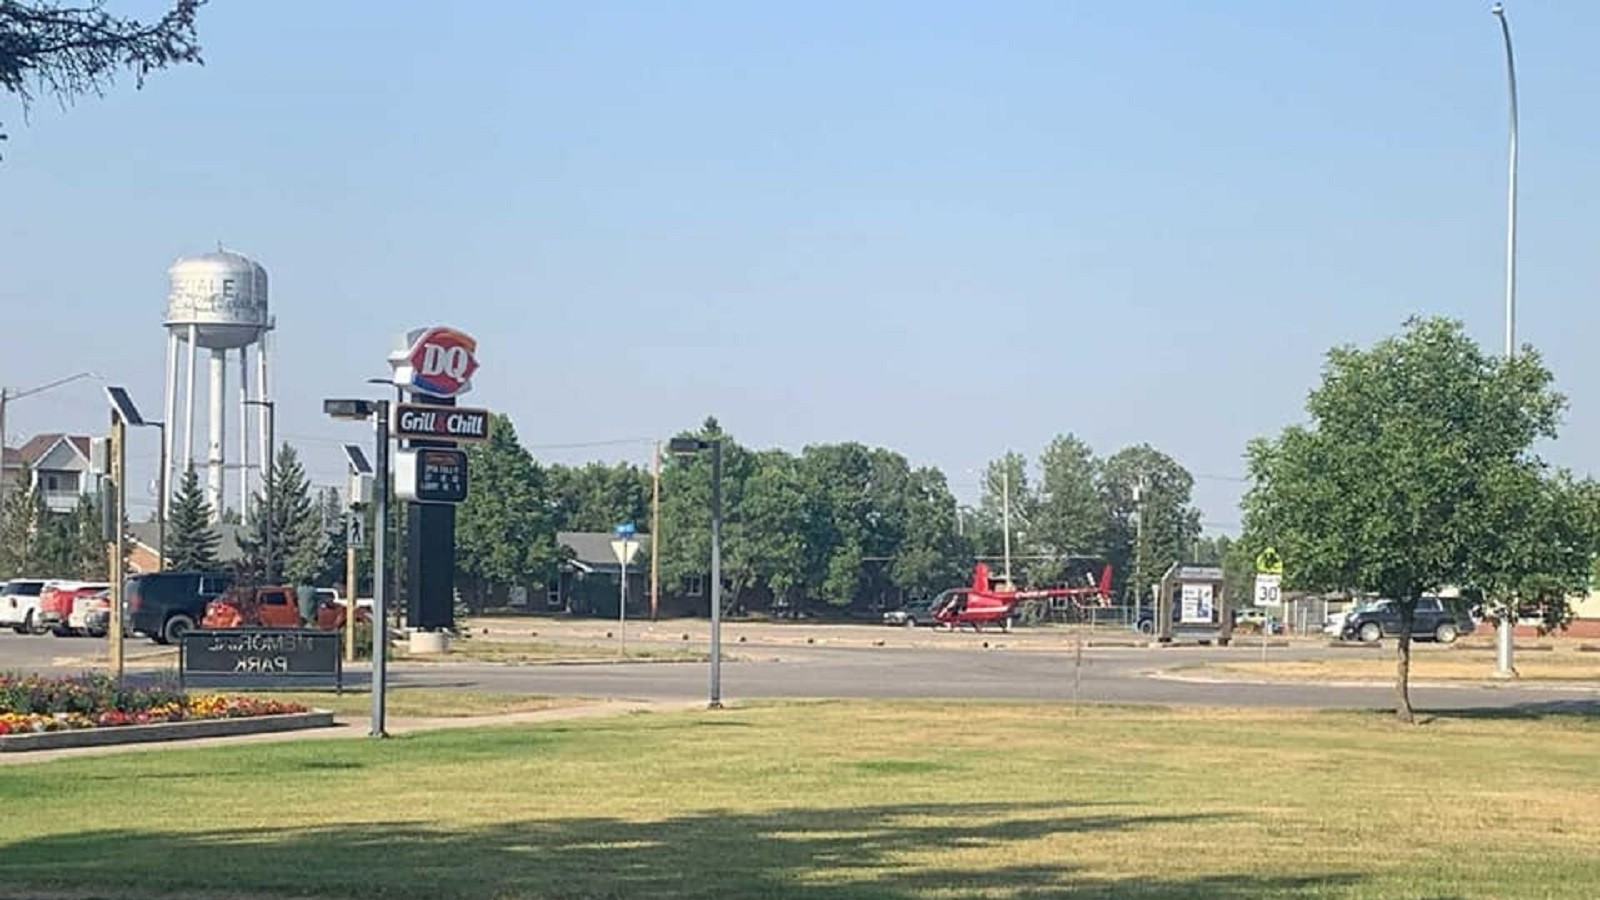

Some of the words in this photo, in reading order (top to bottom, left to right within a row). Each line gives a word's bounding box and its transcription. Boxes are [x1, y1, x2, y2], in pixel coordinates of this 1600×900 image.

[421, 343, 468, 382] DQ
[401, 411, 436, 432] Grill
[447, 413, 483, 434] Chill
[1259, 586, 1278, 601] 30
